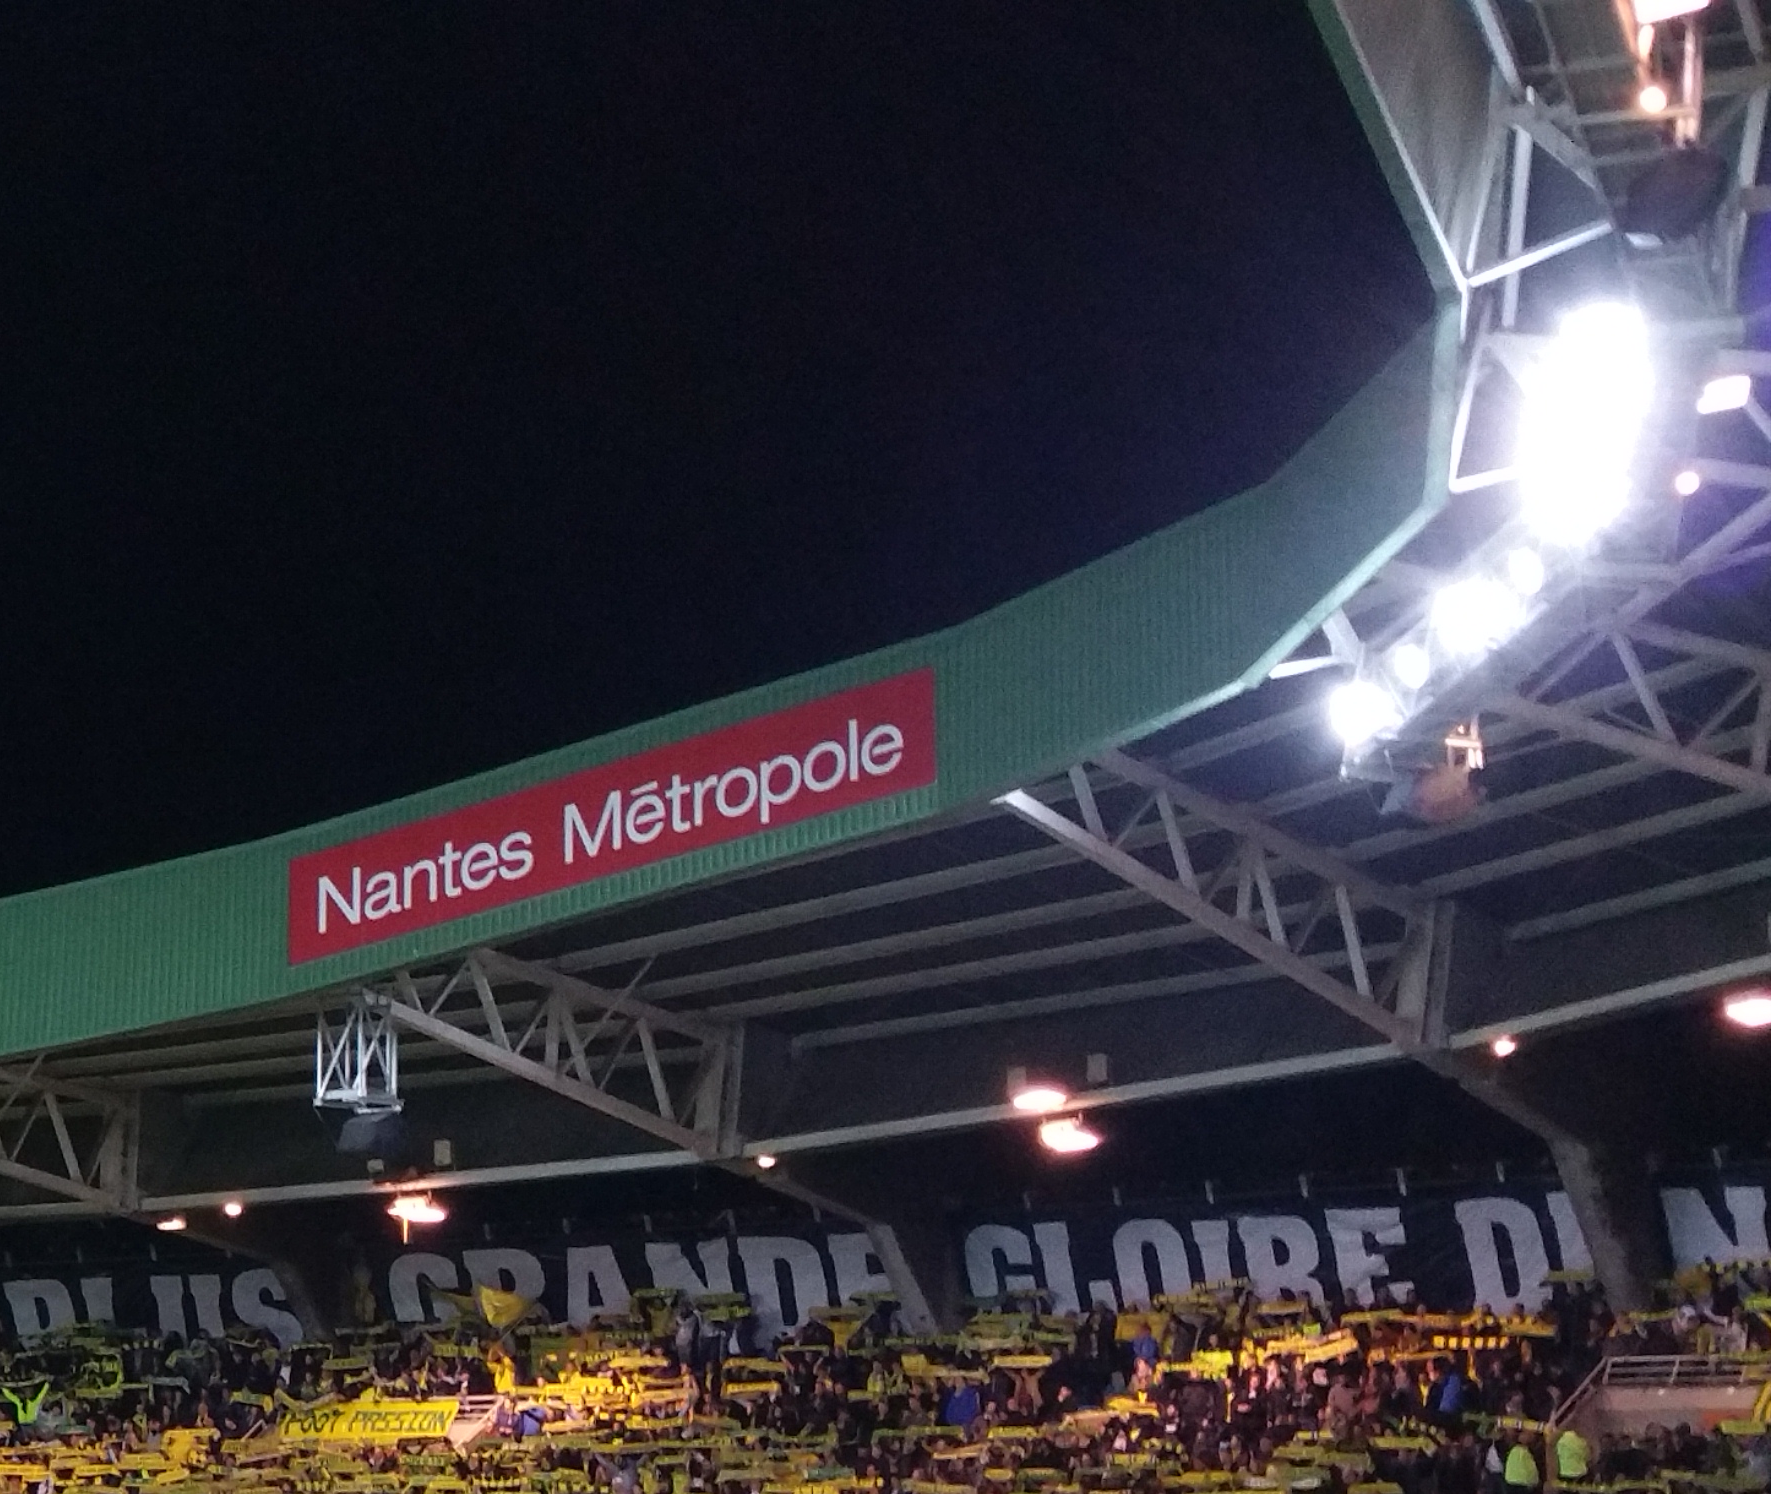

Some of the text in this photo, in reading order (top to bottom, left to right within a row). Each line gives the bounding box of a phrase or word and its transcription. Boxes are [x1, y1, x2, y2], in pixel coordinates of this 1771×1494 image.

[316, 718, 905, 935] Nantes Métropole
[964, 1206, 1414, 1318] GLOIRE
